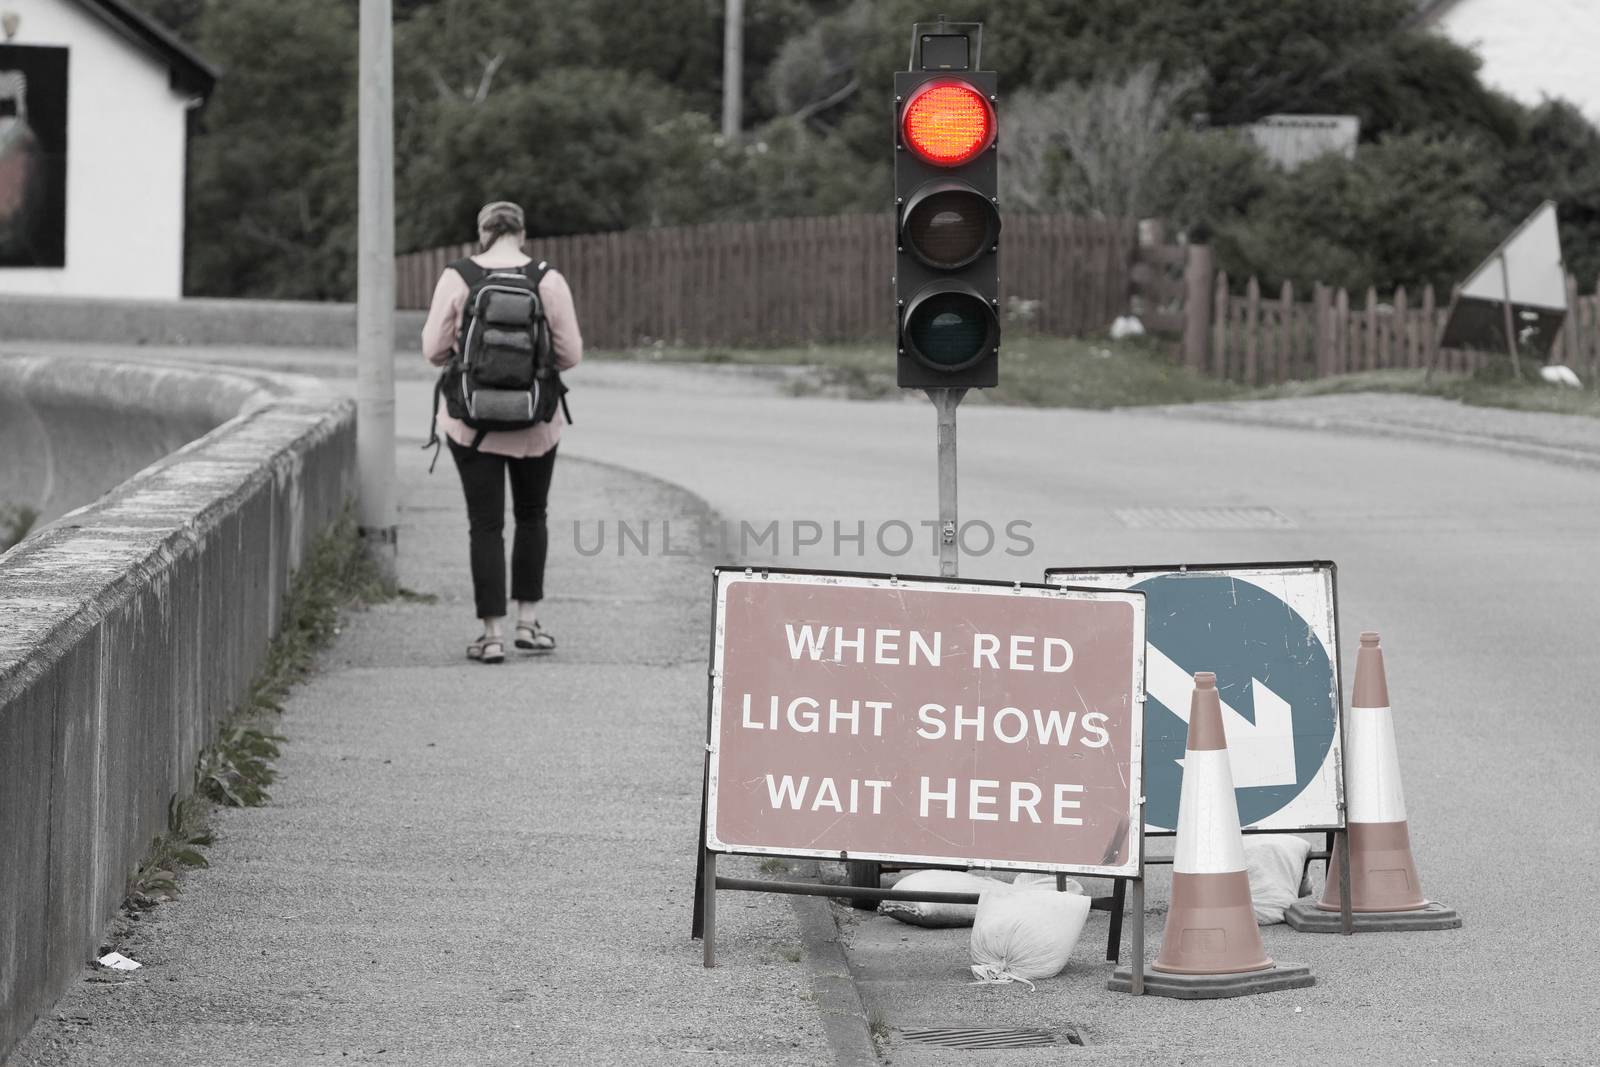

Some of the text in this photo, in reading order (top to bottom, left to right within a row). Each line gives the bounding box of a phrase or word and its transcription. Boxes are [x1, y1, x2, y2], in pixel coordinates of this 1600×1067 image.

[784, 623, 1074, 673] WHEN RED
[741, 694, 1110, 748] LIGHT SHOWS
[765, 775, 1084, 825] WAIT HERE
